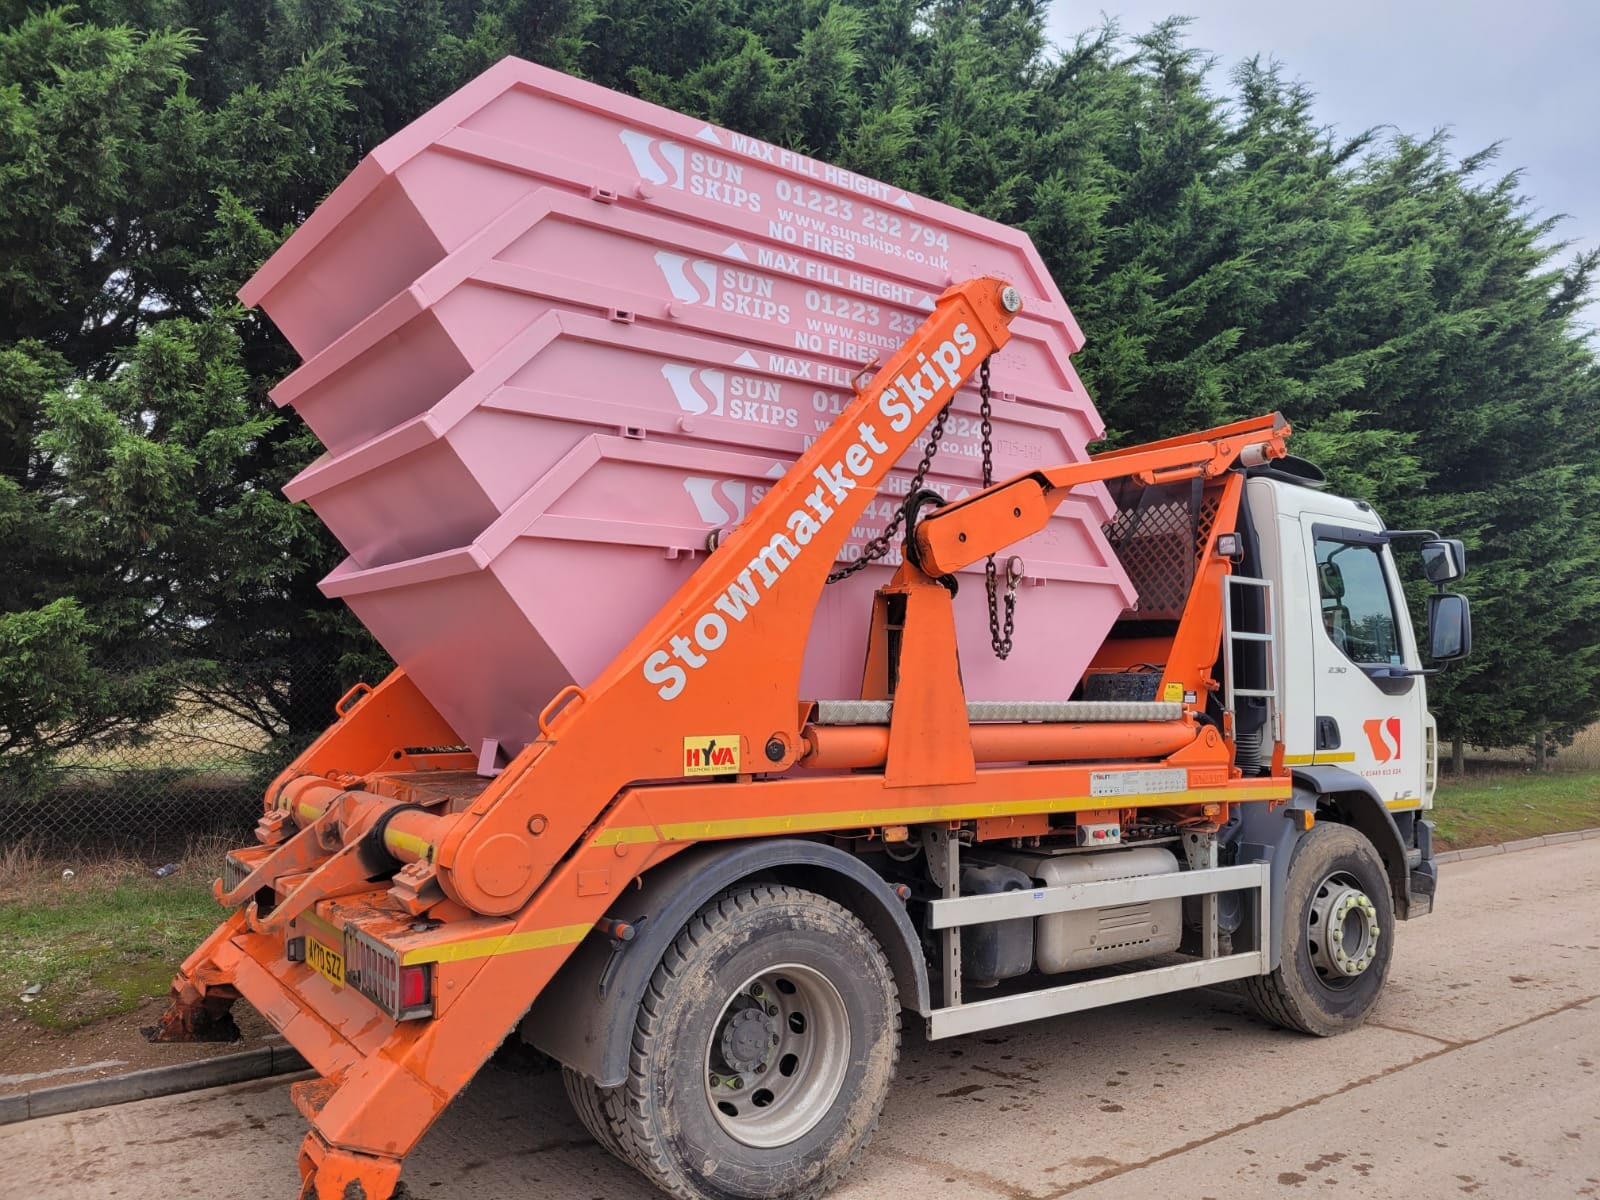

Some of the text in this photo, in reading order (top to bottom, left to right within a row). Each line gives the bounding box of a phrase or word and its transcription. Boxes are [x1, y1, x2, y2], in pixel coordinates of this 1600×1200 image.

[691, 152, 743, 184] SUN
[731, 134, 890, 200] MAX FILL HEIGHT
[690, 176, 761, 212] SKIPS
[776, 180, 949, 252] 01223 232 794
[768, 220, 856, 260] NO FIRES
[778, 209, 949, 270] www.sunskips.co.uk
[723, 269, 773, 298] SUN
[758, 249, 914, 304] MAX FILL HEIGHT
[722, 292, 791, 324] SKIPS
[804, 290, 880, 326] 01223
[795, 331, 880, 365] NO FIRES
[769, 354, 811, 379] MAX
[731, 375, 782, 402] SUN
[729, 400, 799, 428] SKIPS
[643, 321, 977, 701] Stowmarket Skips
[686, 739, 736, 767] HYVA
[309, 938, 342, 981] AY70 SZZ
